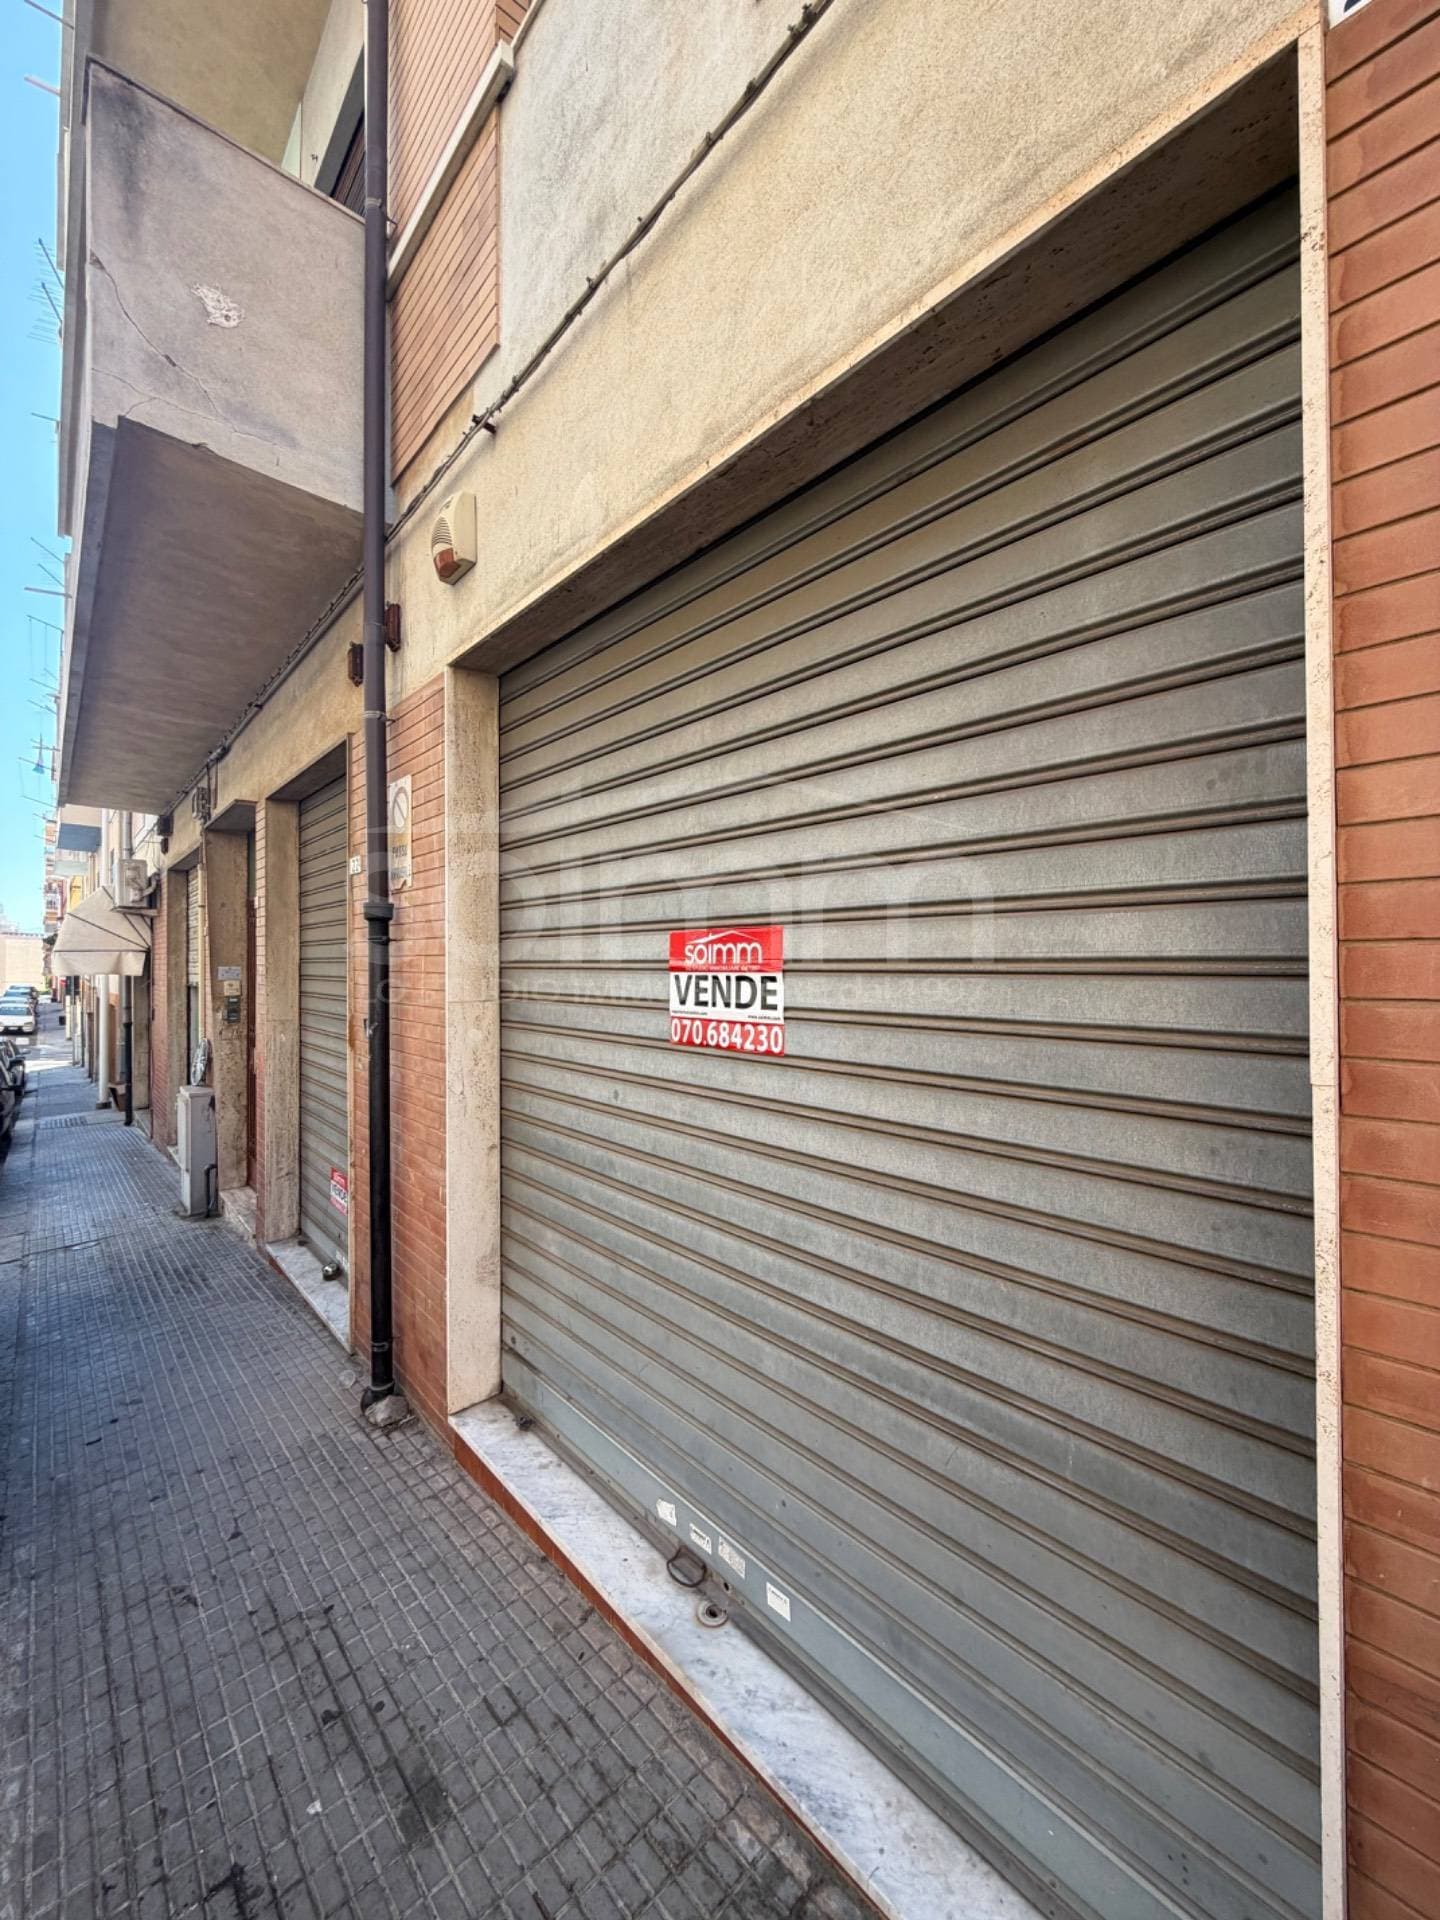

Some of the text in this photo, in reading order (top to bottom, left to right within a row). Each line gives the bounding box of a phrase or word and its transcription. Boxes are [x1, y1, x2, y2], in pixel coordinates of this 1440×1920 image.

[684, 942, 762, 965] soimm
[673, 974, 778, 1011] VENDE
[671, 1018, 783, 1053] 070.684230
